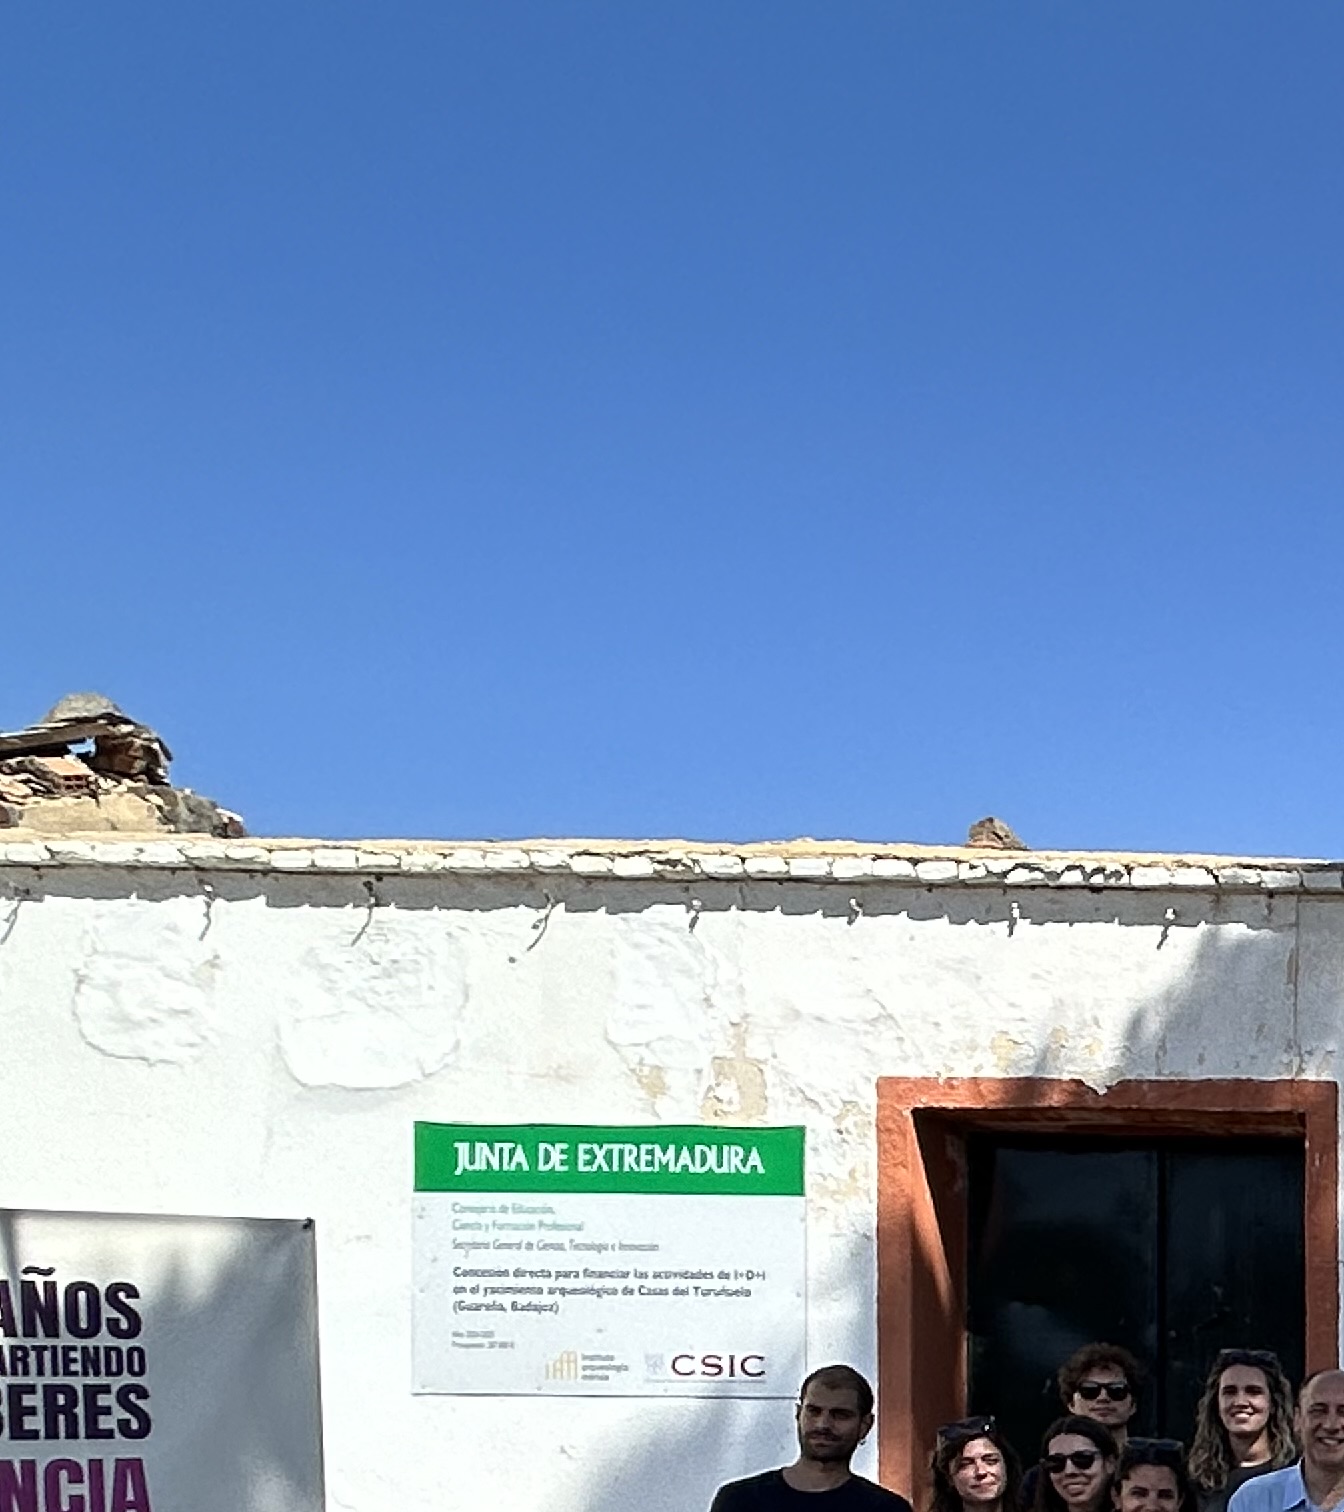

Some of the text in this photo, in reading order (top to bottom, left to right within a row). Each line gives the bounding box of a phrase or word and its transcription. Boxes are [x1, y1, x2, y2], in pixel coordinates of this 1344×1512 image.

[453, 1141, 766, 1176] JUNTA DE EXTREMADURA
[670, 1354, 767, 1378] CSIC
[0, 1382, 153, 1441] ERES
